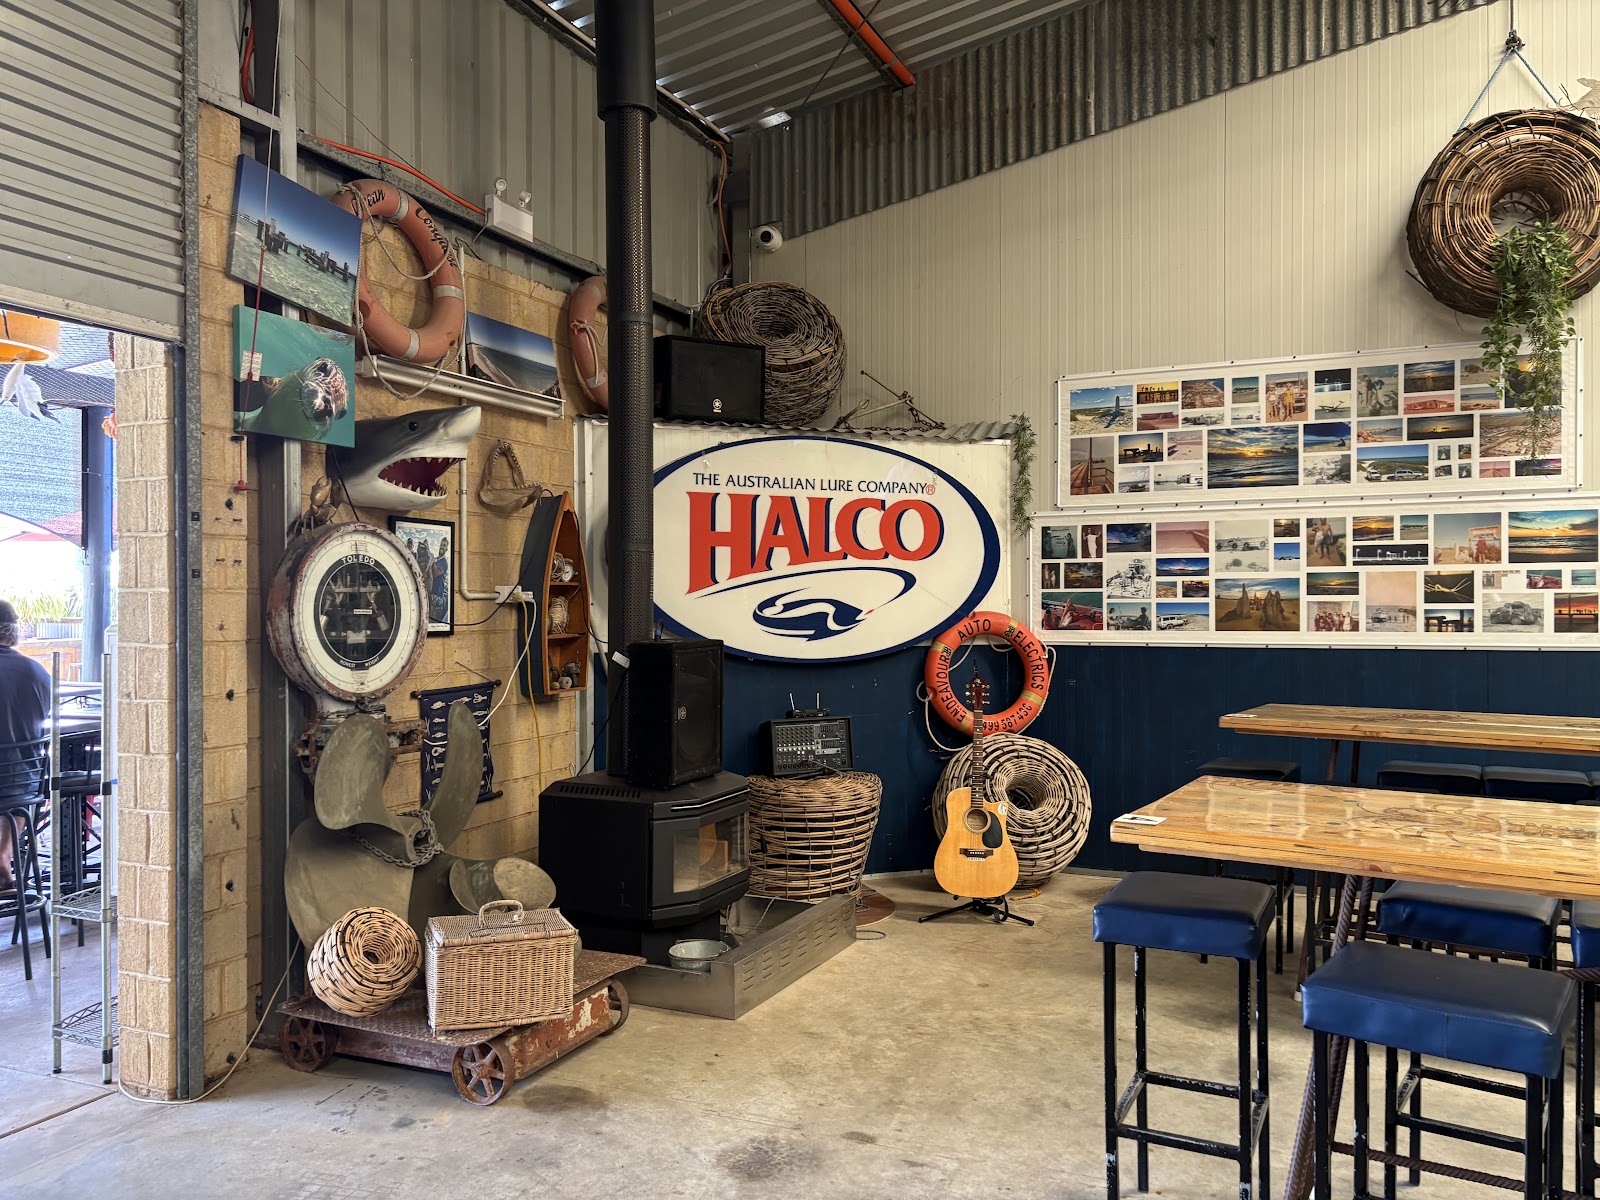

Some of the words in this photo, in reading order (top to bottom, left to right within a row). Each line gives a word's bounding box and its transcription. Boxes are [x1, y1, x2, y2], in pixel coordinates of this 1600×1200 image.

[693, 472, 720, 486] THE
[725, 474, 816, 491] AUSTRALIAN
[820, 478, 854, 492] LURE
[342, 554, 375, 566] TOLEDO
[686, 491, 944, 595] HALCO
[936, 654, 968, 722] ENDEAVOUR
[957, 619, 991, 641] AUTO
[1013, 630, 1045, 691] ELECTRICS
